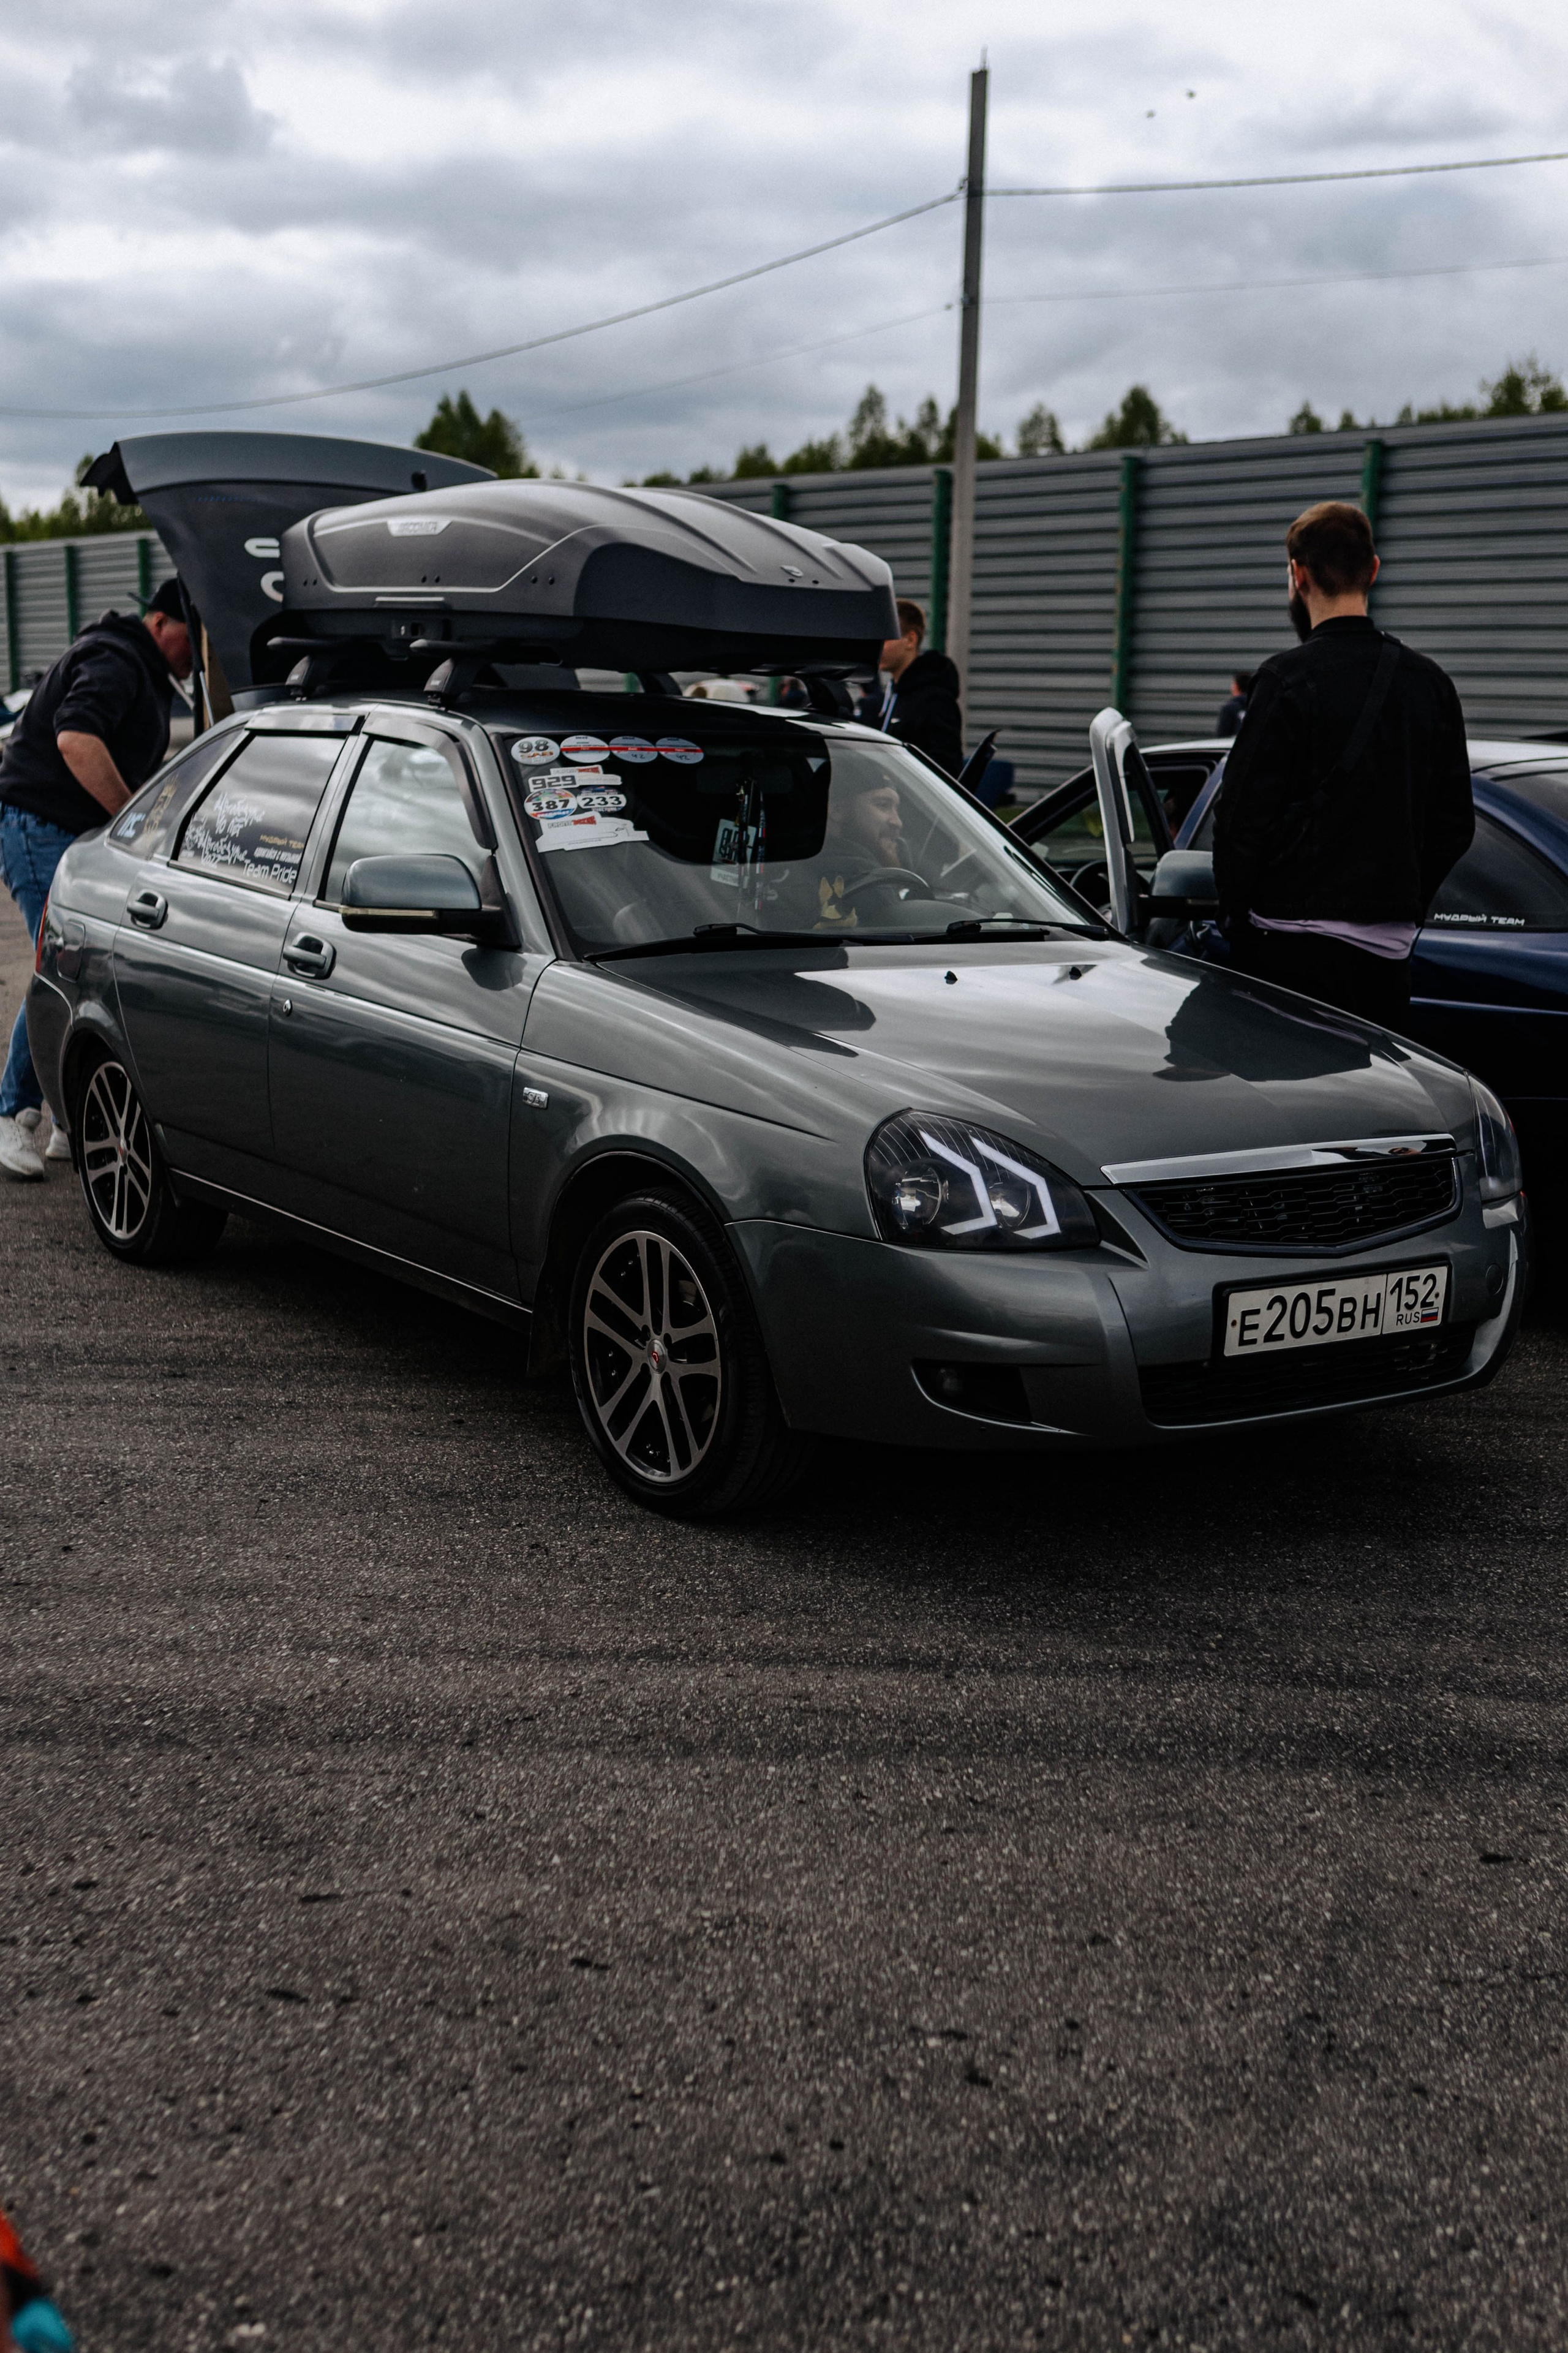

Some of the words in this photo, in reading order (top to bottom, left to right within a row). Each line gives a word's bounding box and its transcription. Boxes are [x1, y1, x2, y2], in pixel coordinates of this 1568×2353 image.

[518, 739, 549, 753] 98
[532, 775, 576, 790] 929
[532, 799, 570, 812] 387
[582, 796, 622, 807] 233
[243, 858, 270, 880] Team
[270, 863, 298, 884] Pride
[1434, 913, 1487, 923] МУДРЫЙ
[1491, 915, 1525, 926] TEAM
[1389, 1273, 1438, 1312] 152
[1396, 1311, 1420, 1326] RUS
